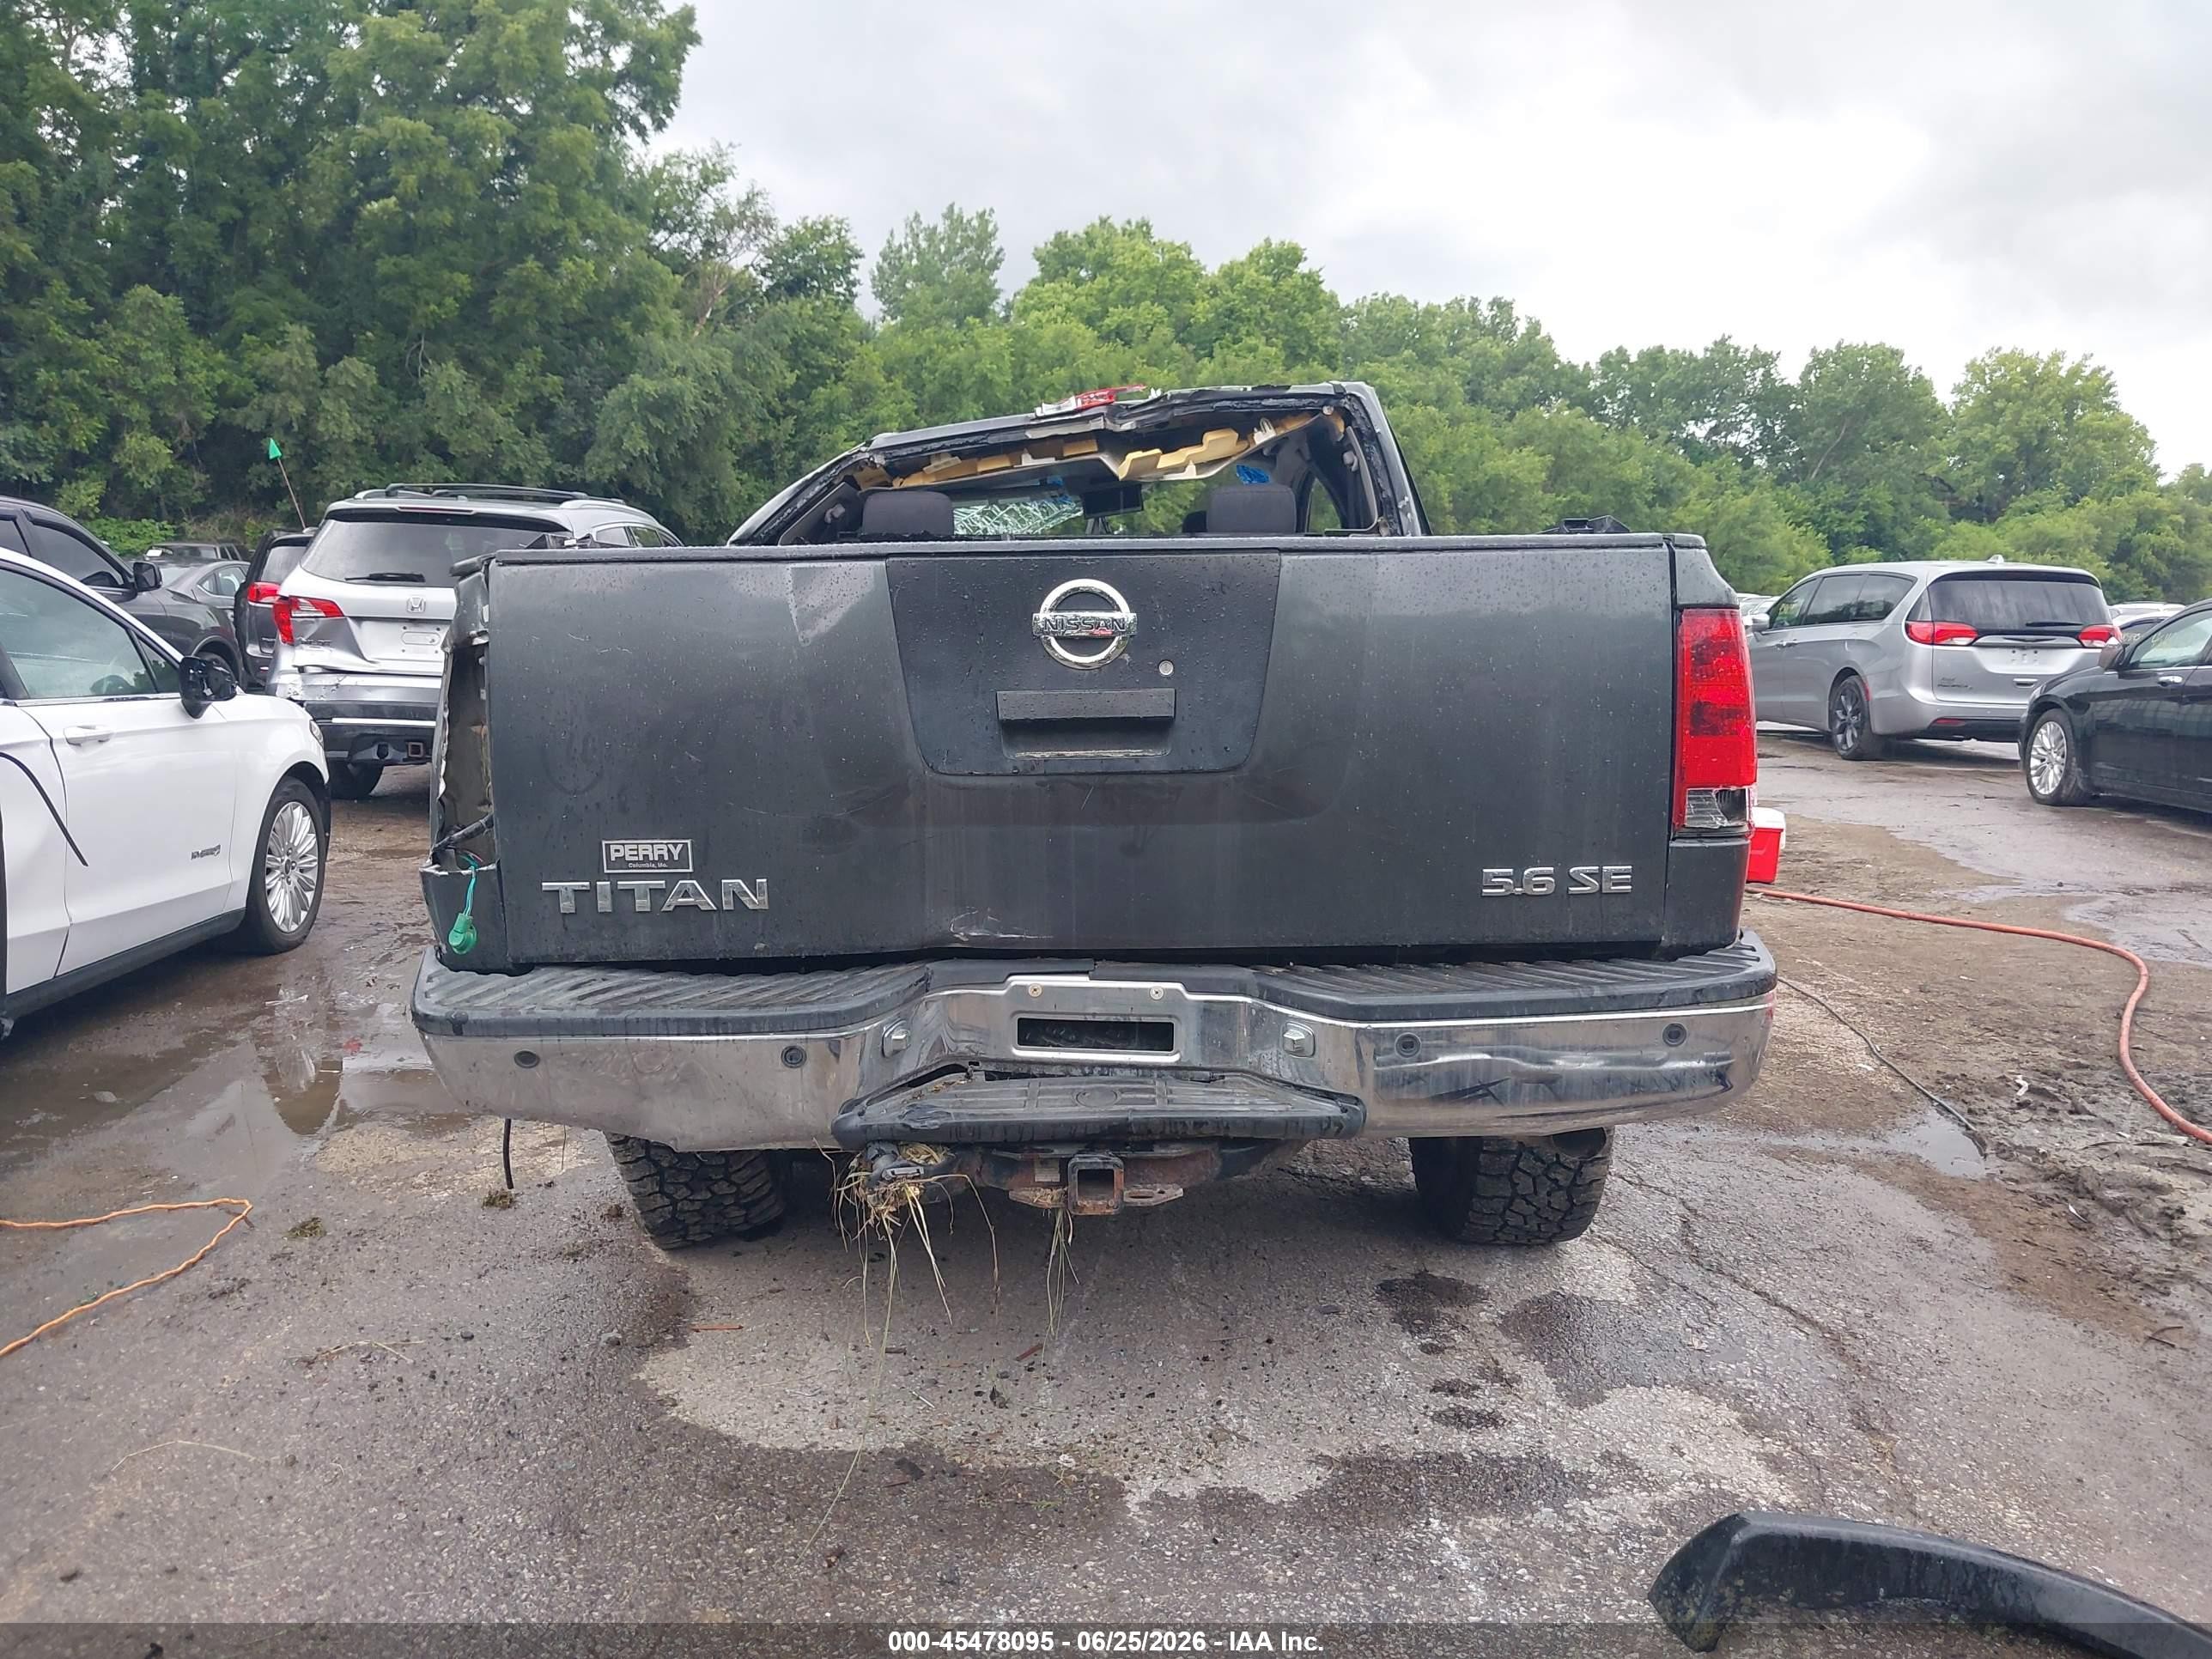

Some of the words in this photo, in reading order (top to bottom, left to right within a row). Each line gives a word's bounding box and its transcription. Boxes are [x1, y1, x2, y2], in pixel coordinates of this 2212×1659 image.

[1043, 617, 1127, 632] NISSAN
[610, 843, 684, 860] PERRY
[1481, 866, 1555, 896] 5.6
[1568, 866, 1632, 894] SE
[542, 879, 769, 914] TITAN
